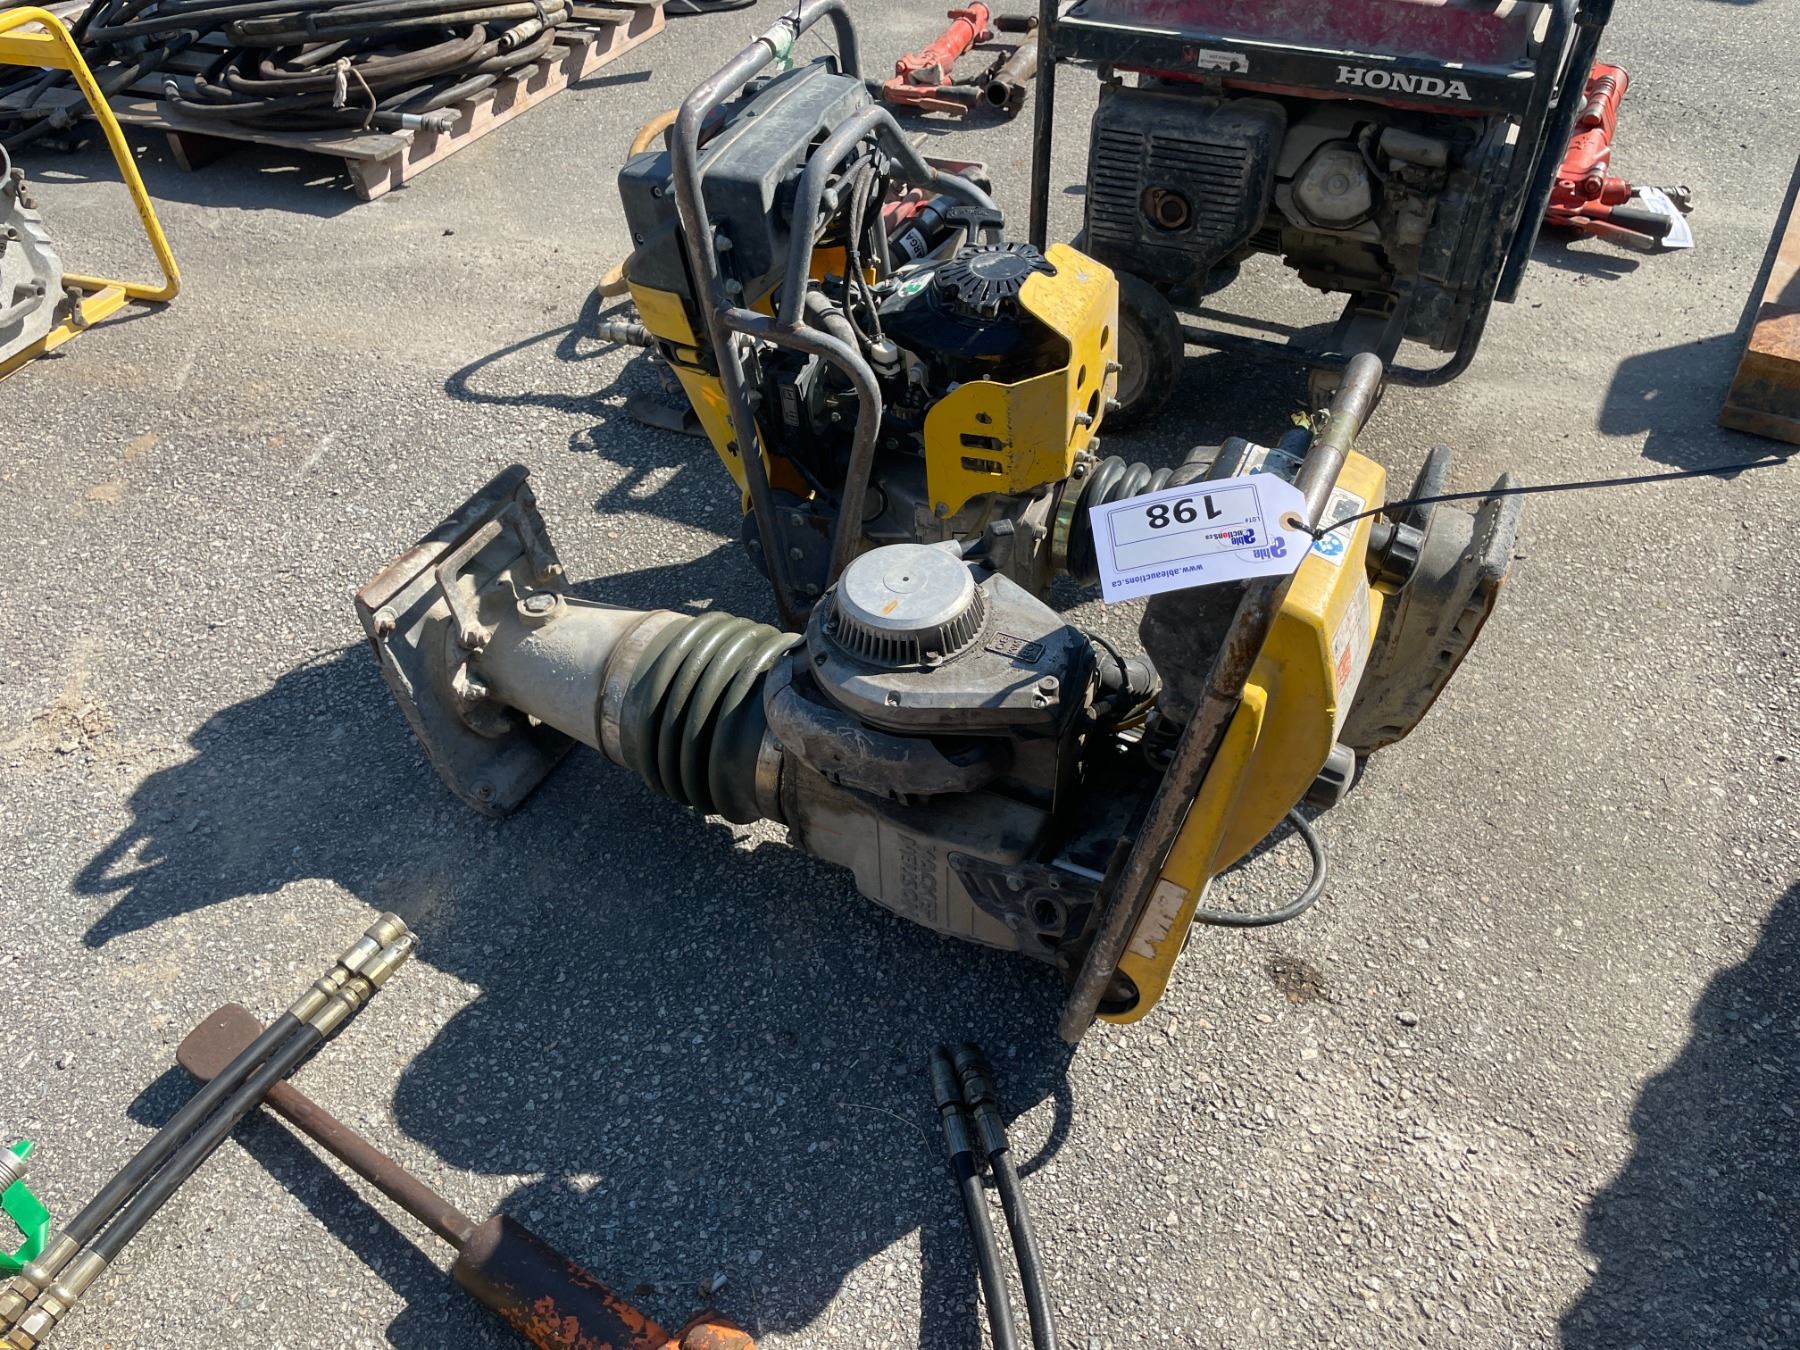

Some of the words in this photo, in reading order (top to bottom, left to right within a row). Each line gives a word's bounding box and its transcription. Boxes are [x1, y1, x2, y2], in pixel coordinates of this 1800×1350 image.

[1336, 66, 1472, 100] HONDA
[1146, 494, 1222, 529] 198
[1112, 564, 1203, 588] www.ableauctions.ca
